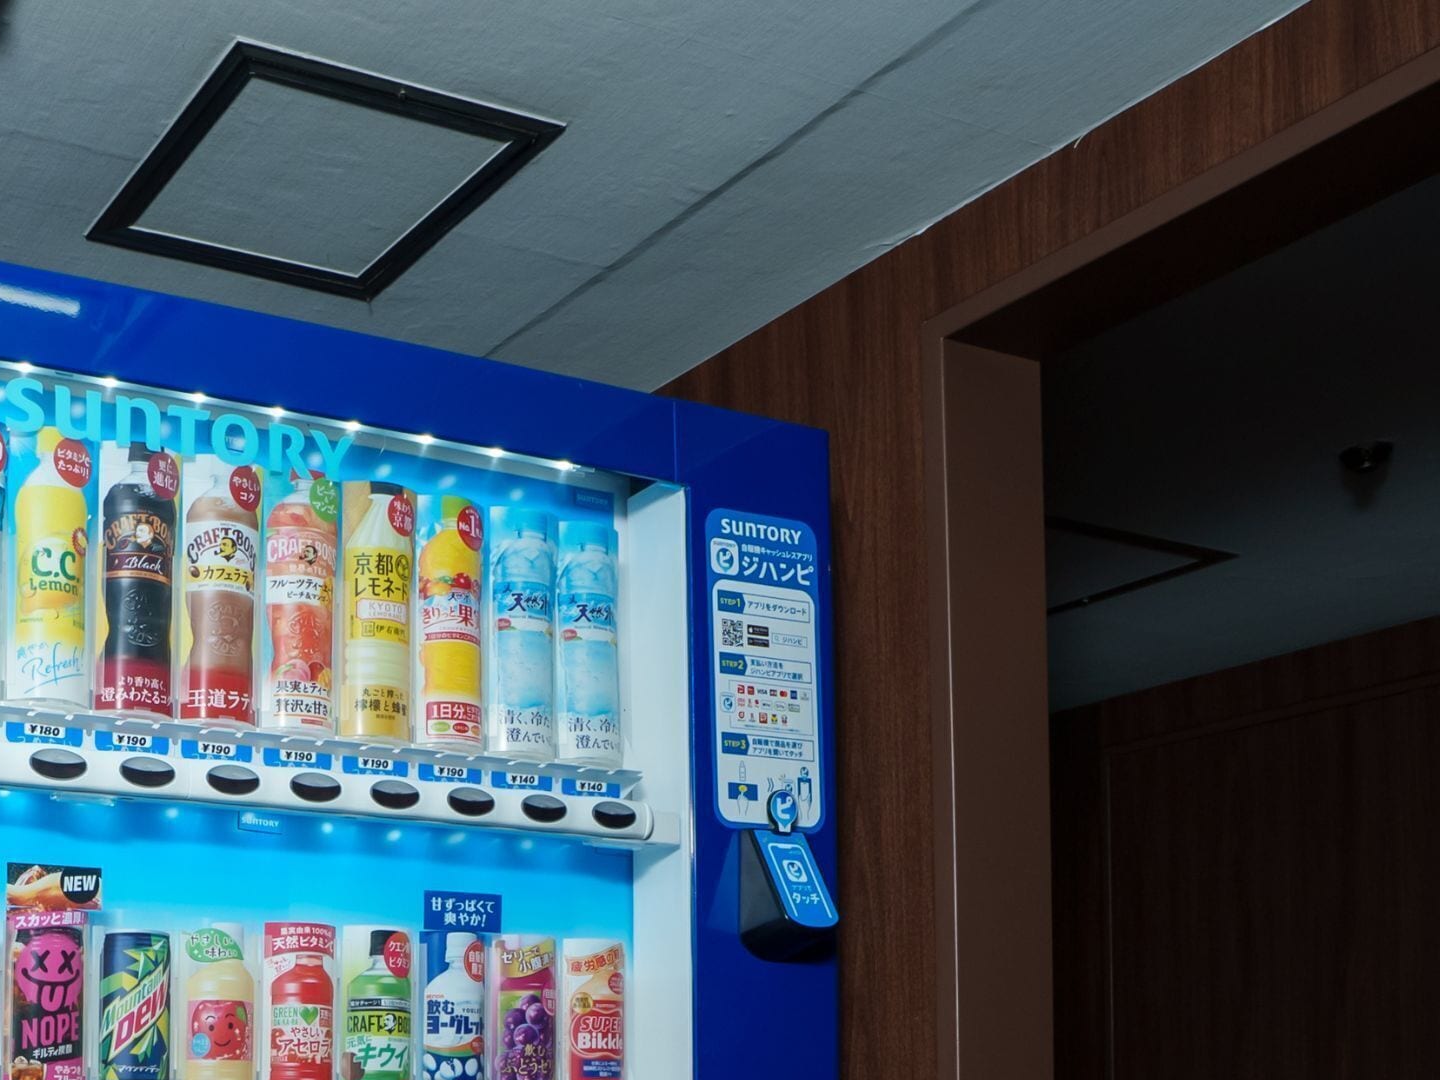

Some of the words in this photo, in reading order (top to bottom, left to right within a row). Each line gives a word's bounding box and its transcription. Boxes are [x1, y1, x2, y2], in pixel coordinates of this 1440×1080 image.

[5, 377, 354, 482] SUNTORY
[240, 491, 255, 504] コク
[104, 512, 150, 550] CRAFT
[720, 518, 802, 545] SUNTORY
[187, 527, 232, 564] CRAFT
[31, 548, 80, 584] C.C.
[122, 554, 164, 575] Black
[353, 552, 394, 576] 京都
[741, 555, 815, 586] ジハンピ
[203, 565, 250, 584] カフェラテ
[29, 577, 79, 598] Lemon
[354, 577, 408, 601] レモネード
[28, 724, 62, 738] ¥180
[114, 733, 148, 748] ¥190
[199, 742, 232, 757] ¥190
[282, 750, 314, 763] ¥190
[360, 757, 390, 771] ¥190
[436, 765, 465, 778] ¥190
[508, 773, 537, 786] ¥140
[575, 780, 604, 793] ¥140
[62, 875, 97, 893] NEW
[431, 896, 496, 914] 甘ずっぱくて
[791, 893, 820, 905] タッチ
[15, 912, 86, 929] スカッと濃厚!
[443, 912, 487, 928] 爽やか!
[190, 934, 234, 946] やさしい
[273, 1006, 299, 1018] GREEN
[426, 999, 456, 1015] 飲む
[21, 1010, 80, 1050] NOPE
[290, 1026, 325, 1039] やさしい
[347, 1014, 381, 1034] CRAFT
[278, 1037, 331, 1057] アセロラ
